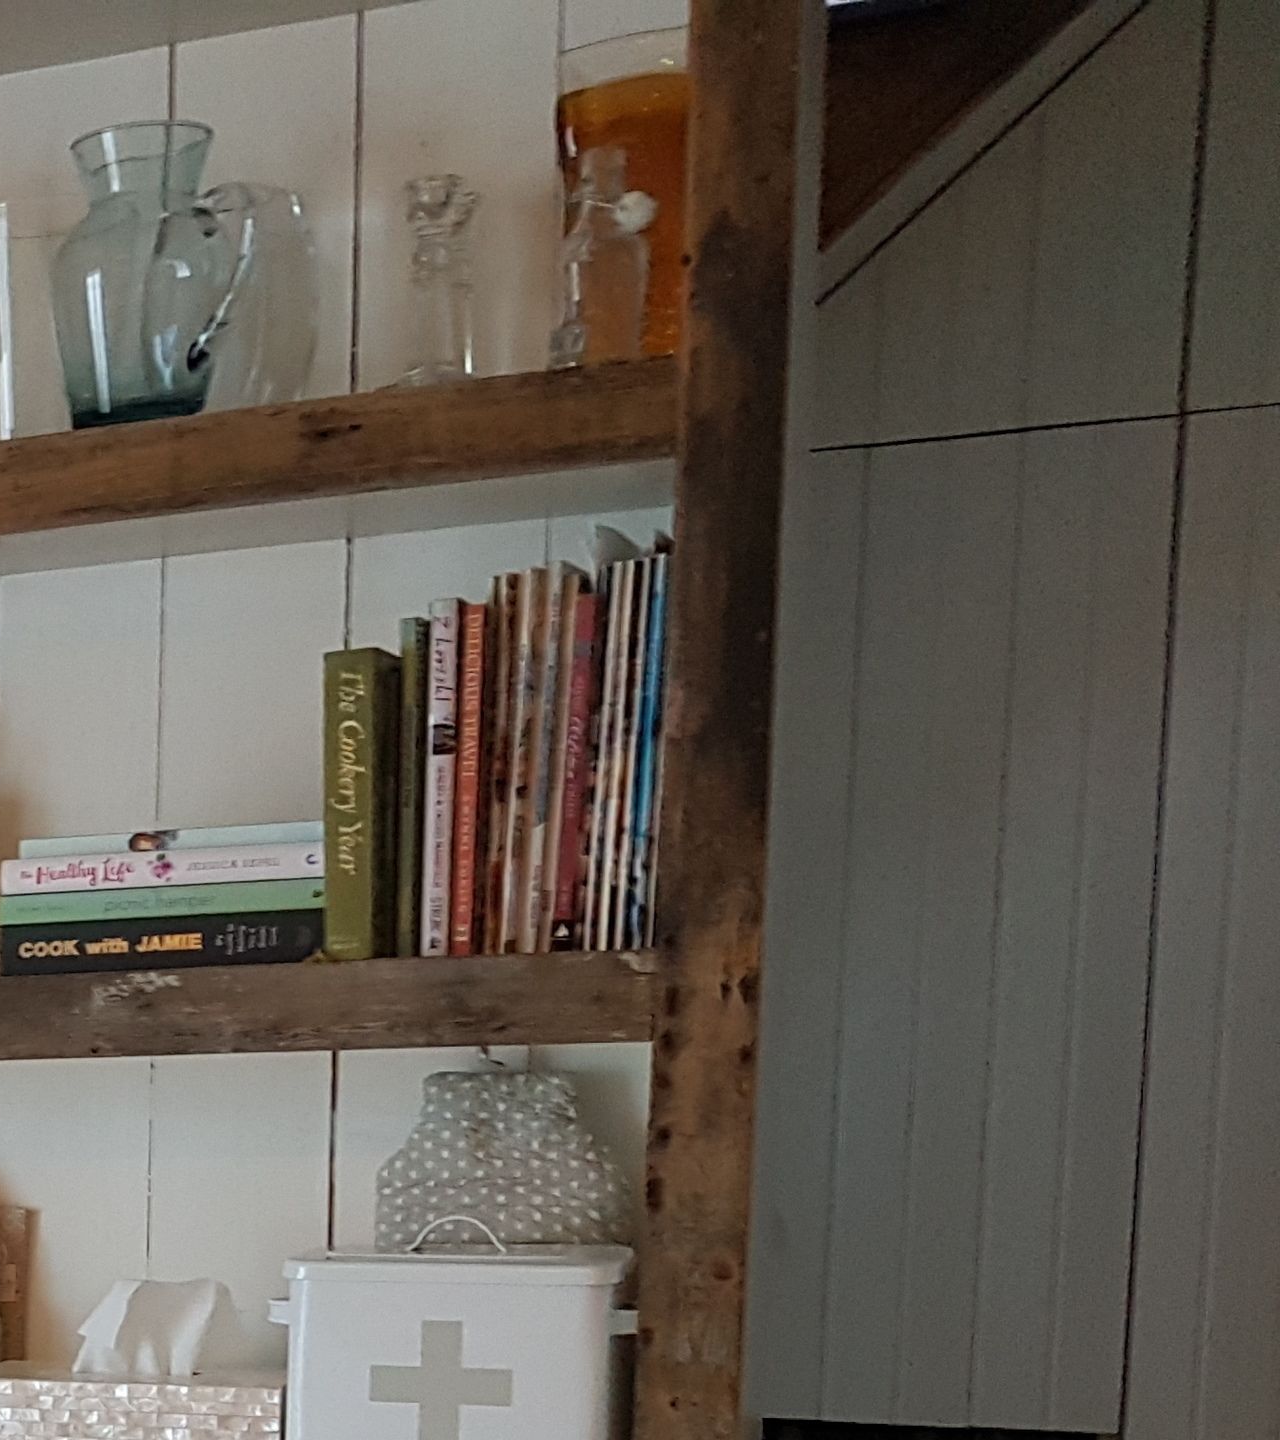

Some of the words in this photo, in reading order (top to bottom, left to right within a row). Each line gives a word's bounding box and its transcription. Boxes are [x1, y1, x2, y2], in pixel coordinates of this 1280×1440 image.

[464, 613, 482, 711] DELICIOUS
[339, 671, 367, 715] The
[329, 718, 367, 813] Cookery
[462, 718, 480, 776] TRAVEL
[36, 859, 97, 886] Healthy
[102, 857, 135, 882] Life
[337, 820, 364, 877] Year
[17, 939, 80, 959] COOK
[85, 936, 130, 955] with
[135, 932, 204, 953] JAMIE
